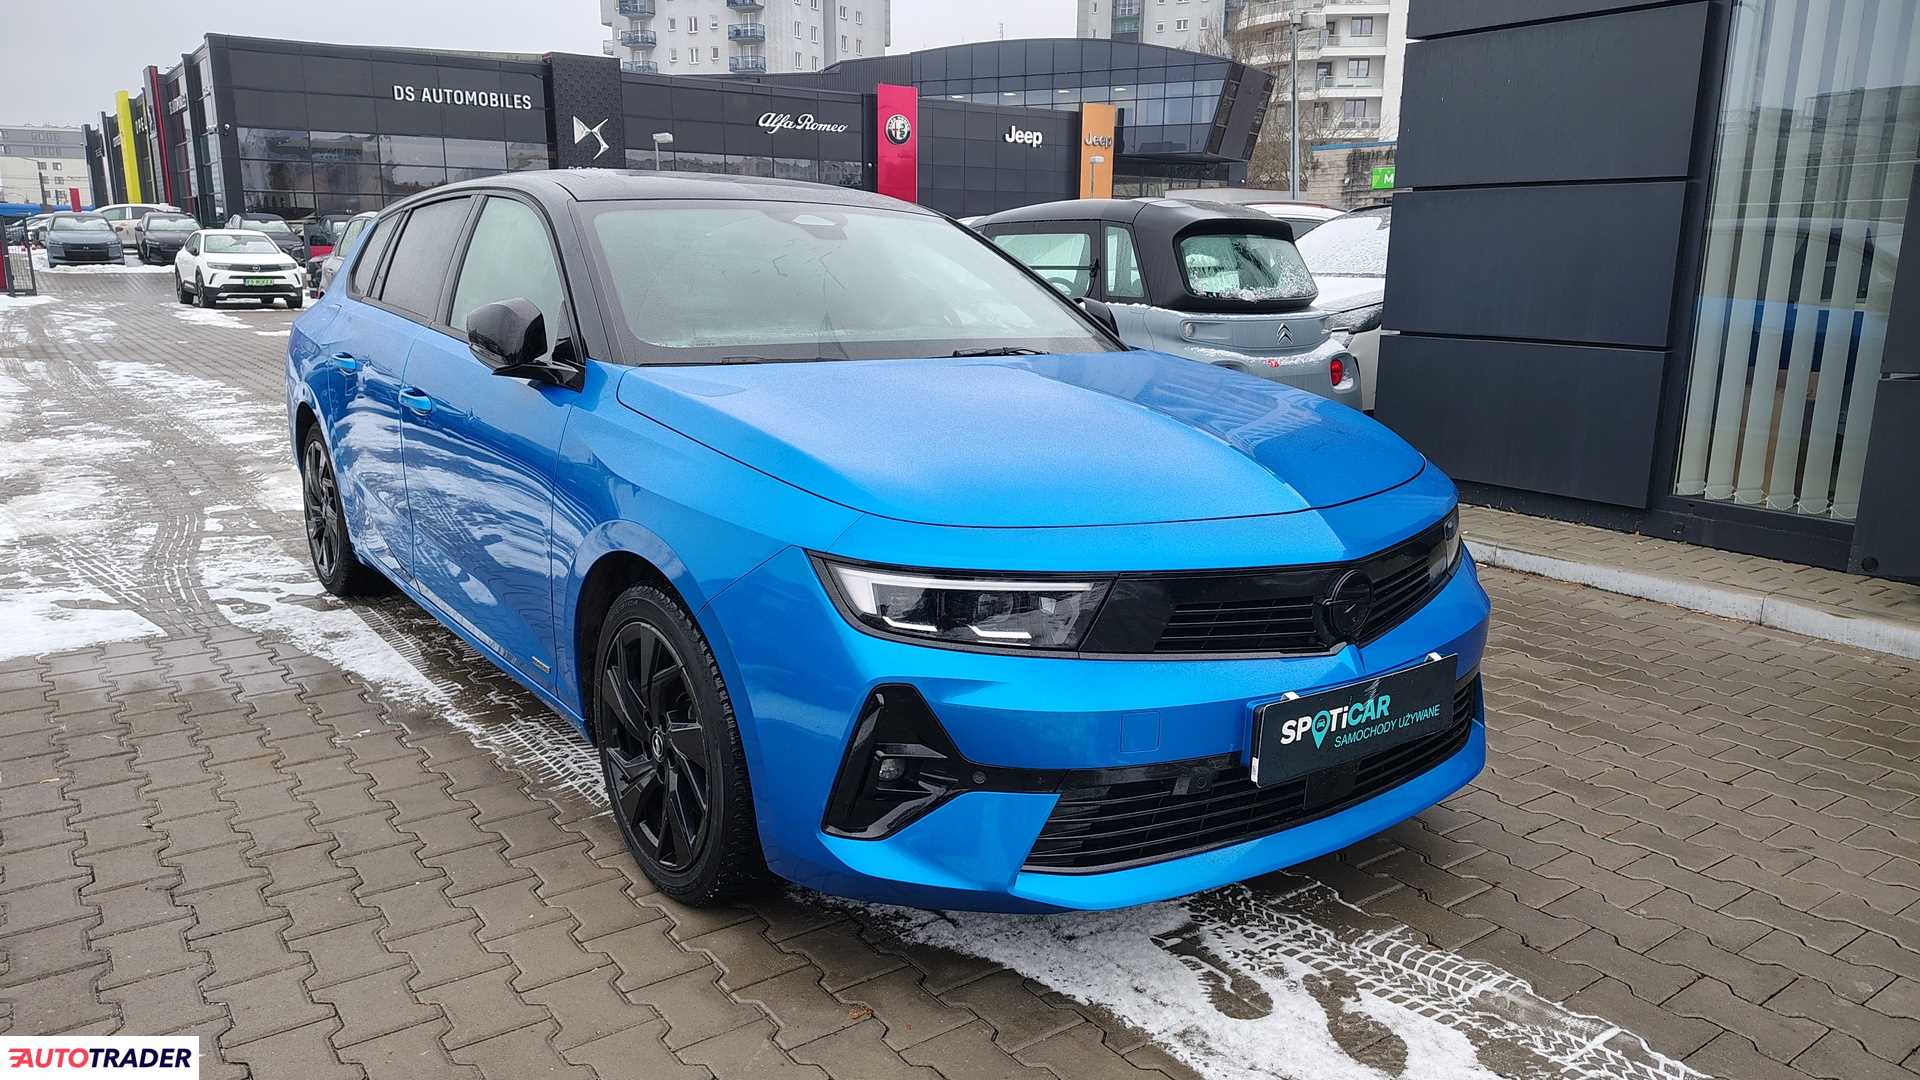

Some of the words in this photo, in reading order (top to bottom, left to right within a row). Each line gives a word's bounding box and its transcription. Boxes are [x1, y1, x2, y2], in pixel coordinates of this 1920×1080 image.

[393, 85, 415, 102] DS
[421, 87, 532, 110] AUTOMOBILES
[758, 112, 796, 134] Alfa
[796, 113, 849, 133] Romeo
[1005, 125, 1043, 148] Jeep
[1334, 720, 1396, 748] SAMOCHODY
[1398, 703, 1441, 728] UŻYWANE
